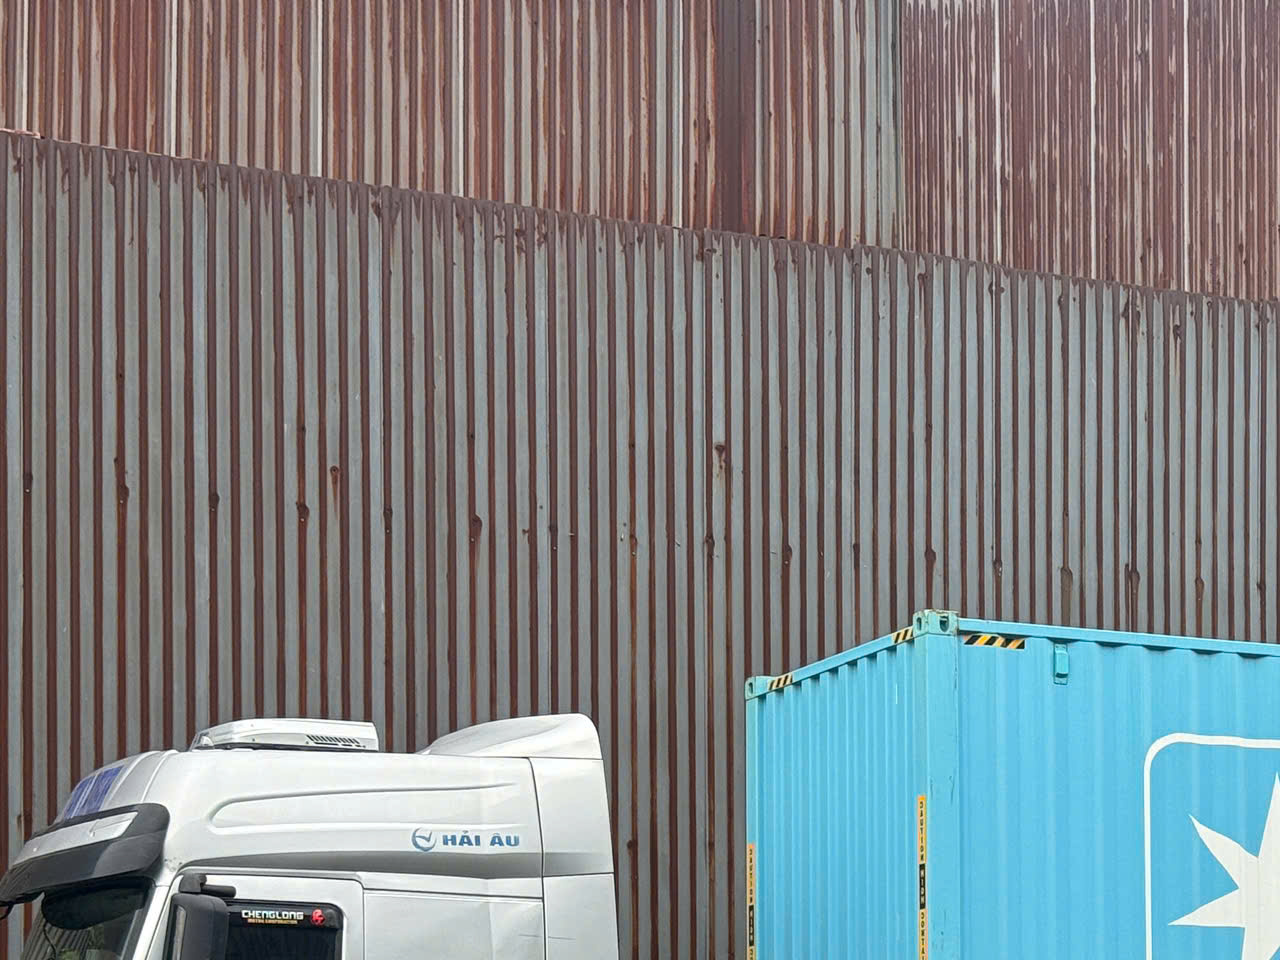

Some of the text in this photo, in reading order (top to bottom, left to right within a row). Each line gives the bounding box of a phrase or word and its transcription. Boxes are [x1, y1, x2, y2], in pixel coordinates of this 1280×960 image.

[442, 830, 520, 847] HẢI ÂU
[241, 909, 305, 920] CHENGLONG
